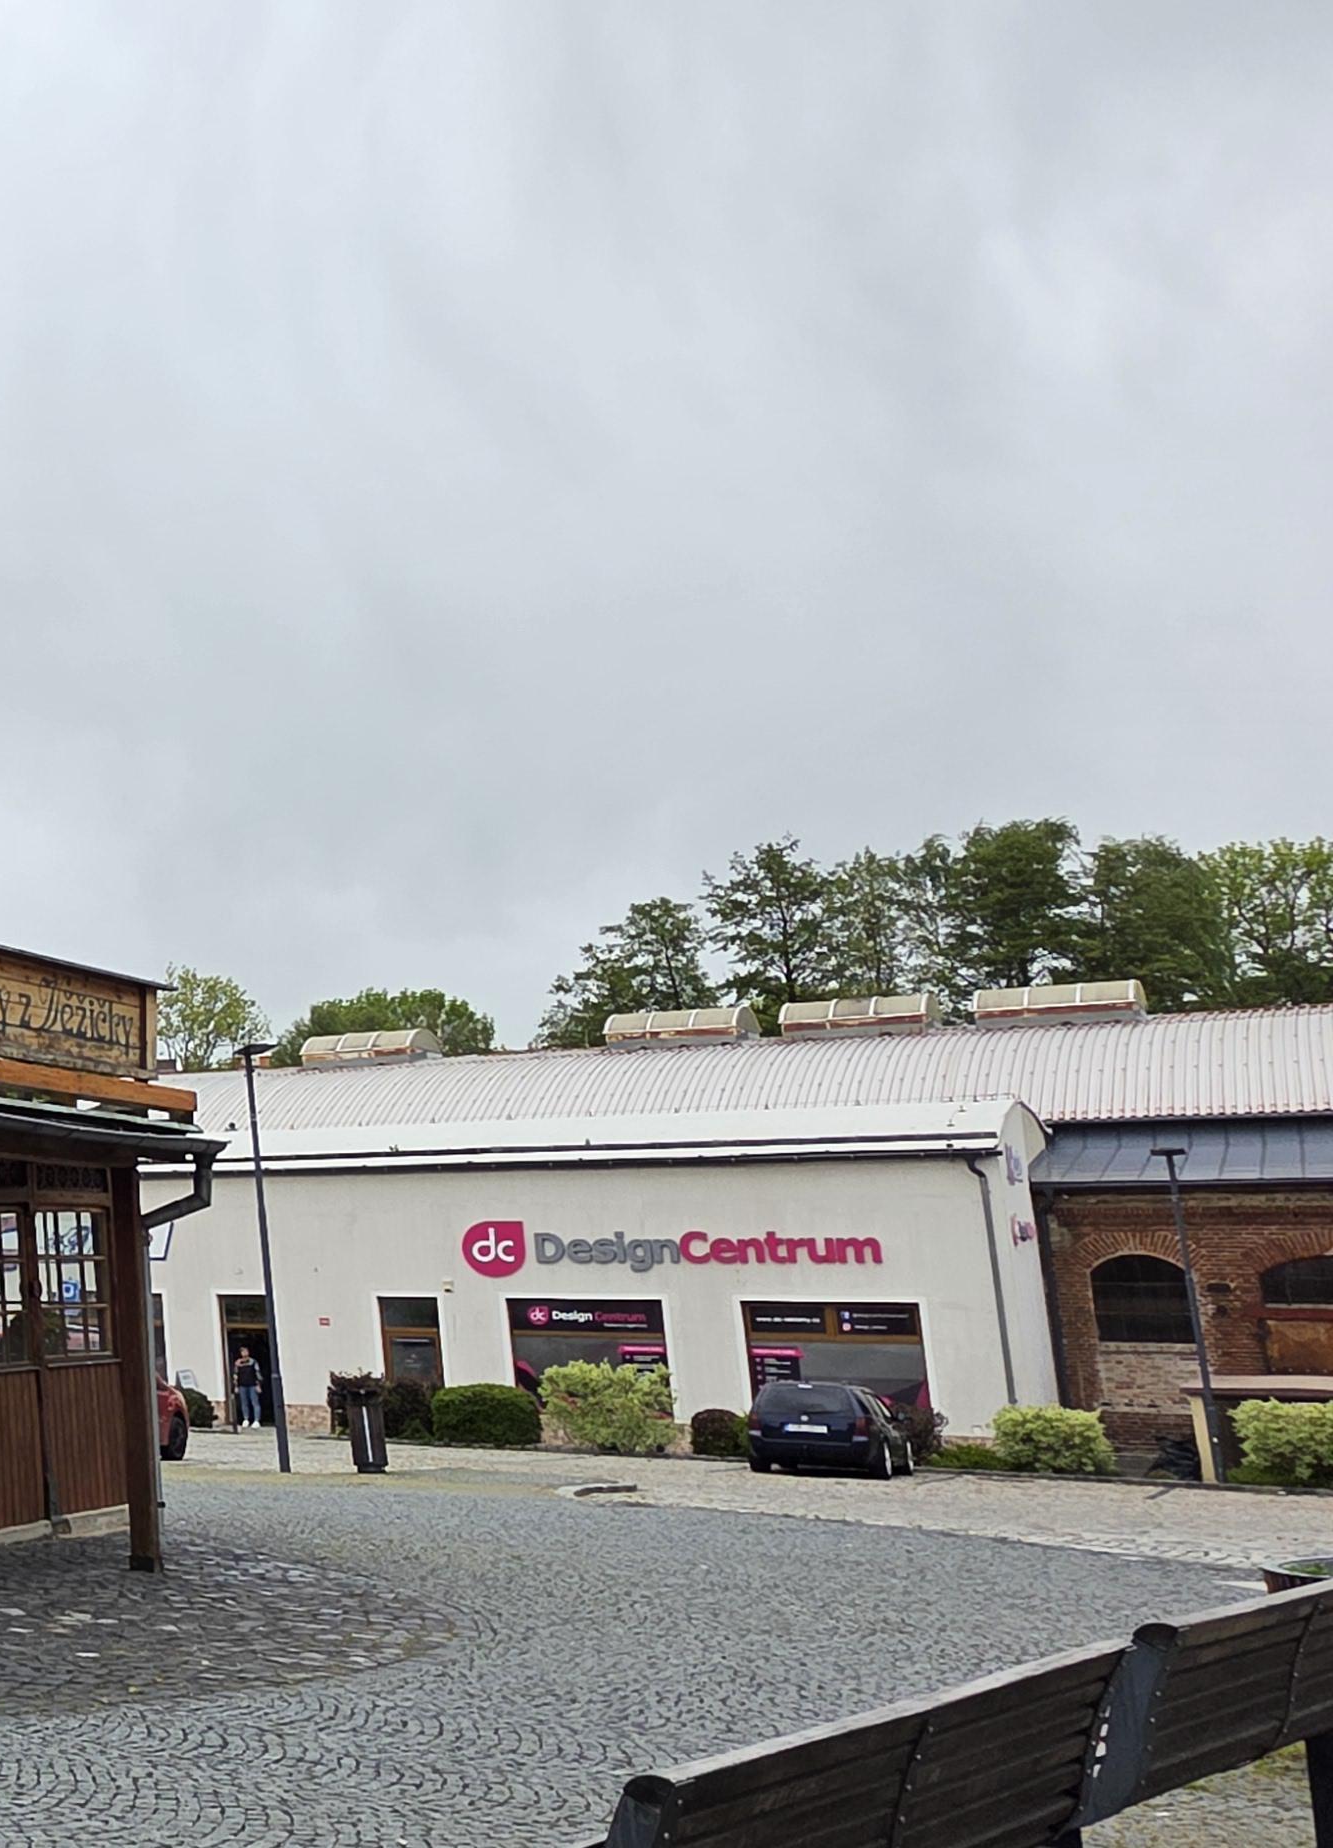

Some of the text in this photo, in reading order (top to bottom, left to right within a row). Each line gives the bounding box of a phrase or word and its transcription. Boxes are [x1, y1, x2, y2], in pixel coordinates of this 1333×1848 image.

[18, 992, 32, 1028] z
[471, 1227, 883, 1273] dc DesignCentrum
